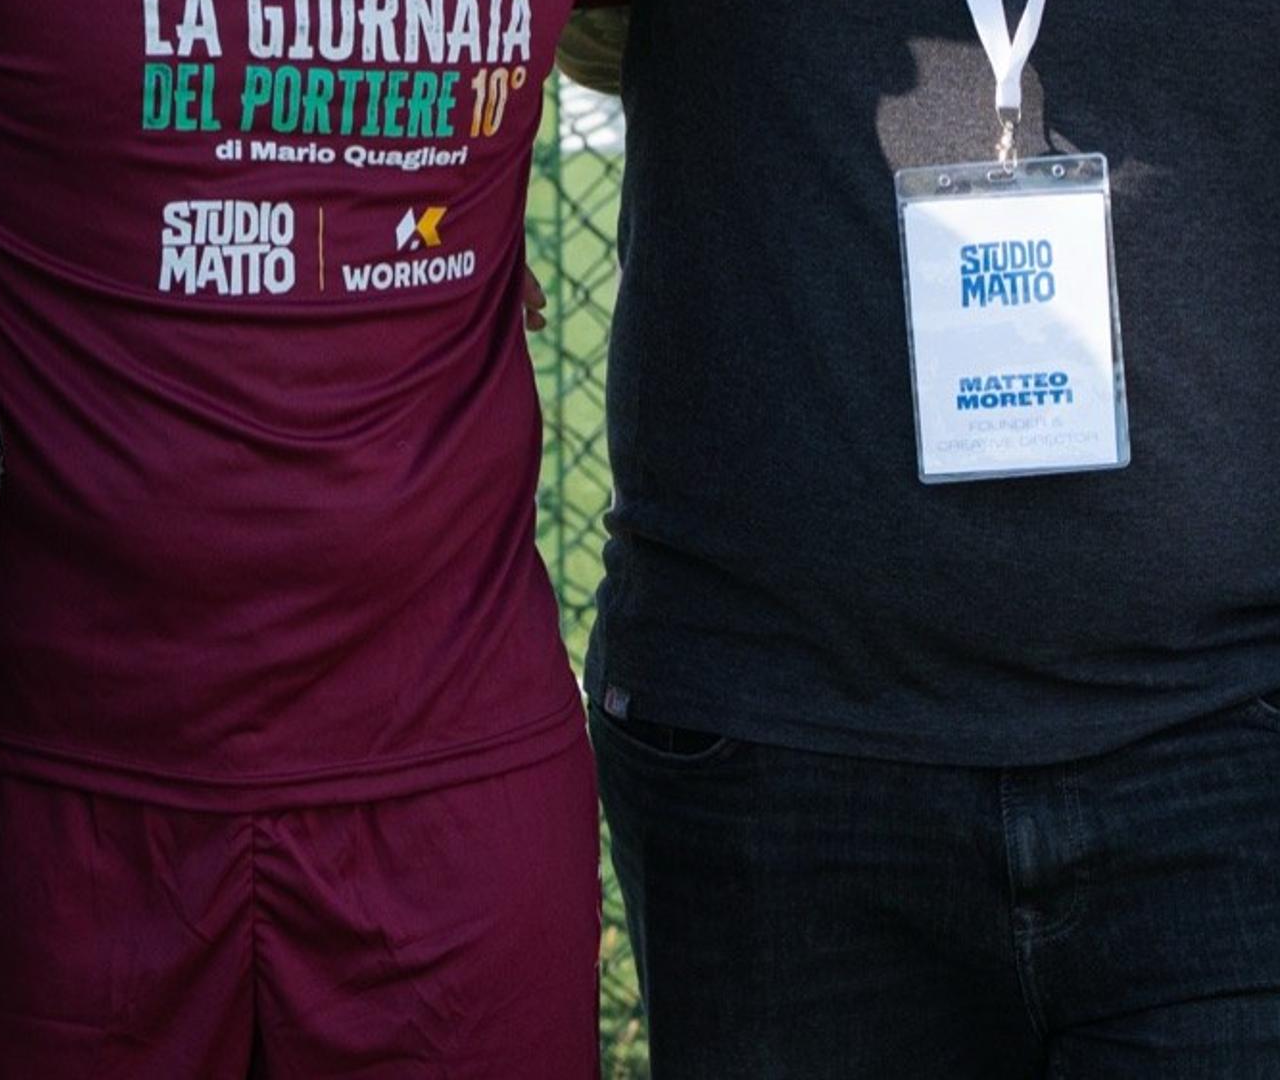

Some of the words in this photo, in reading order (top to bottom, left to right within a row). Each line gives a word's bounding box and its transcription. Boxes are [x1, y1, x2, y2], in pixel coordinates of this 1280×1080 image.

[141, 62, 223, 131] DEL
[240, 65, 462, 139] PORTIERE
[215, 140, 243, 161] di
[250, 140, 336, 165] Mario
[344, 143, 468, 171] Quaglieri
[161, 200, 296, 246] STUDIO
[158, 244, 296, 296] MATTO
[342, 249, 476, 293] WORKOND
[960, 238, 1054, 276] STUDIO
[960, 268, 1056, 309] MATTO
[956, 388, 1074, 411] MORETTI
[958, 371, 1069, 392] MATTEO
